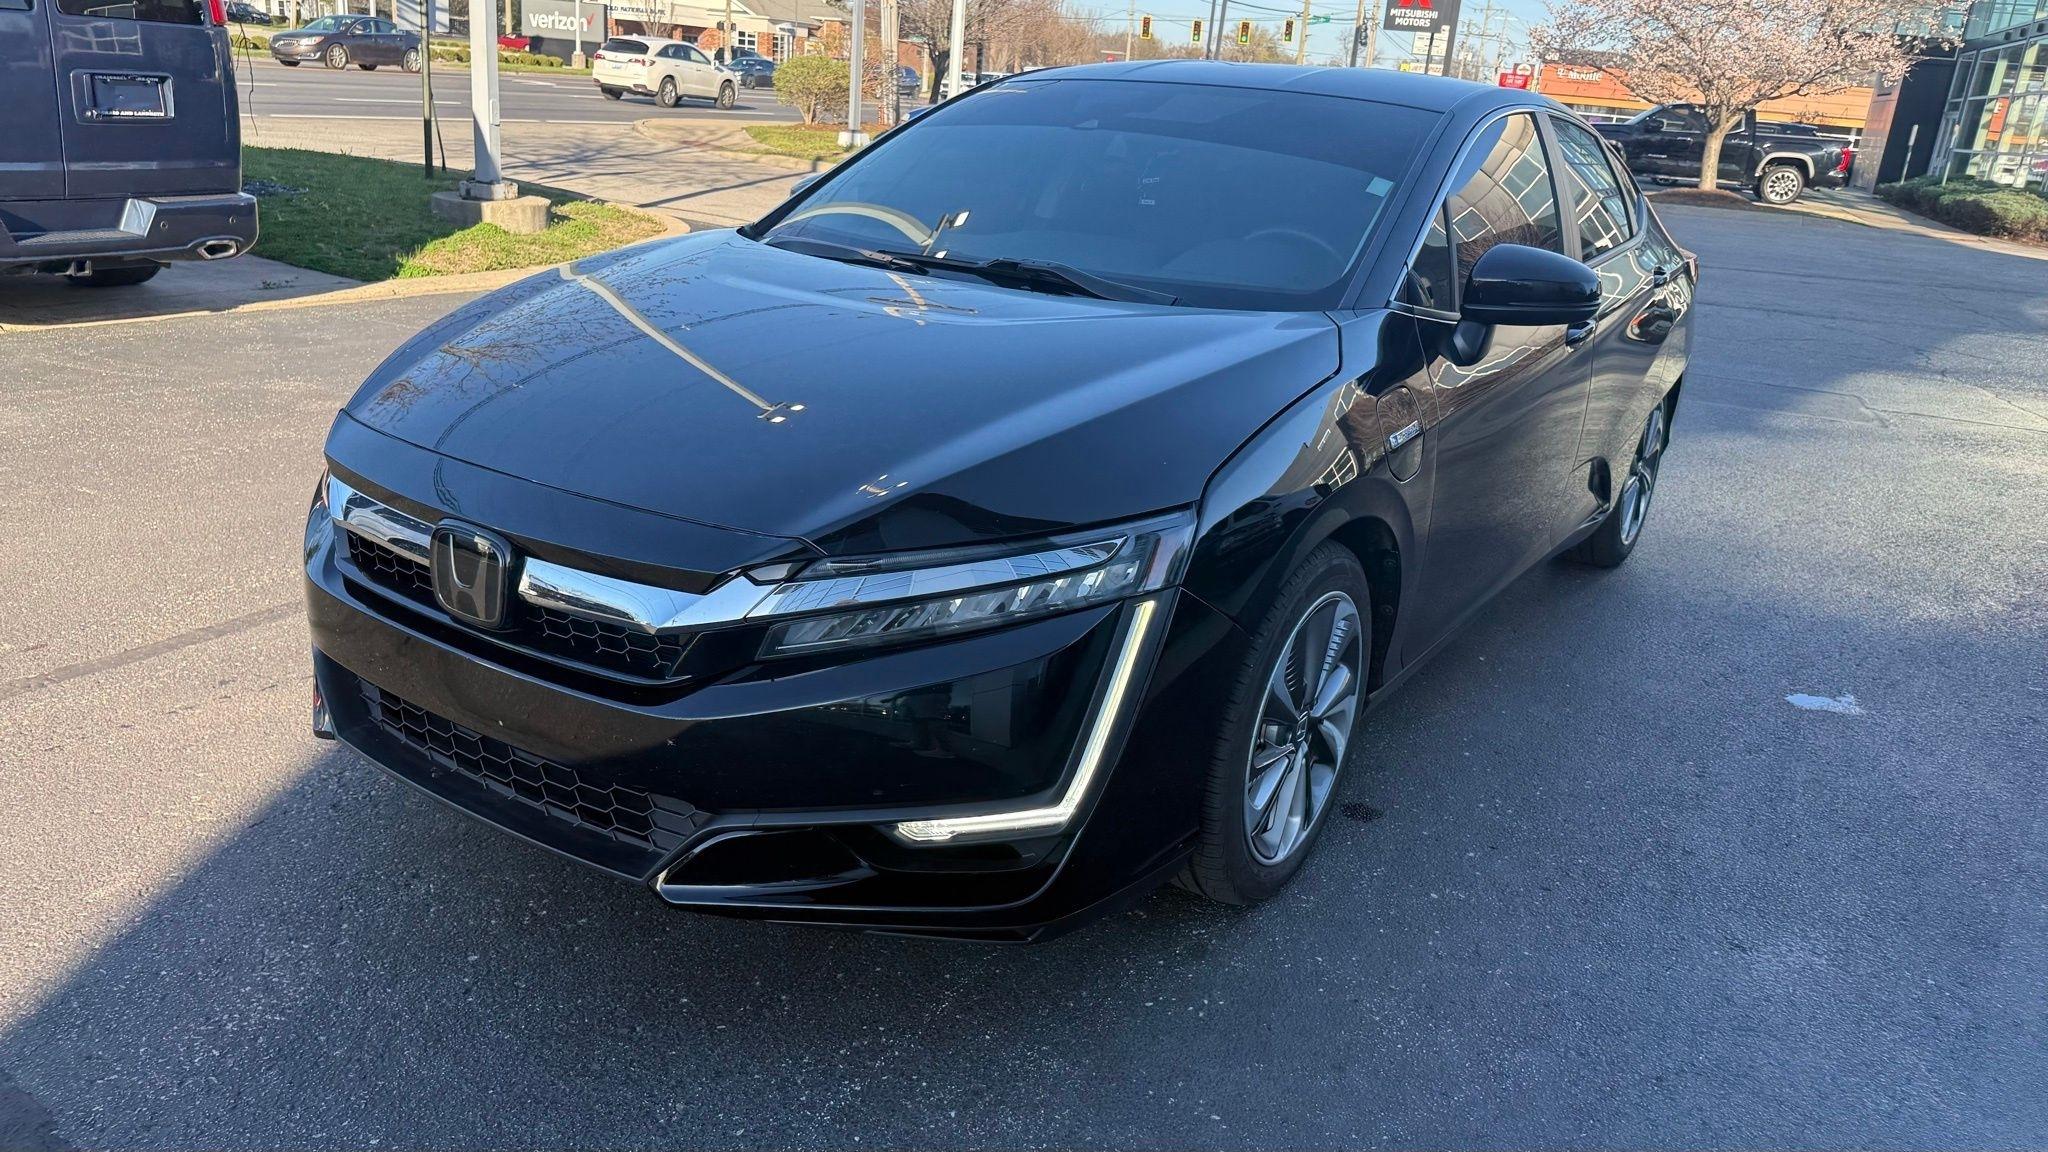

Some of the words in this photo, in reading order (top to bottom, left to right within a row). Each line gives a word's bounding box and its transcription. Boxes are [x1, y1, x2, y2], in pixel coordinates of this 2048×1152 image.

[1390, 8, 1439, 20] MITSUBISHI
[528, 10, 588, 32] verizon
[1394, 17, 1431, 27] MOTORS
